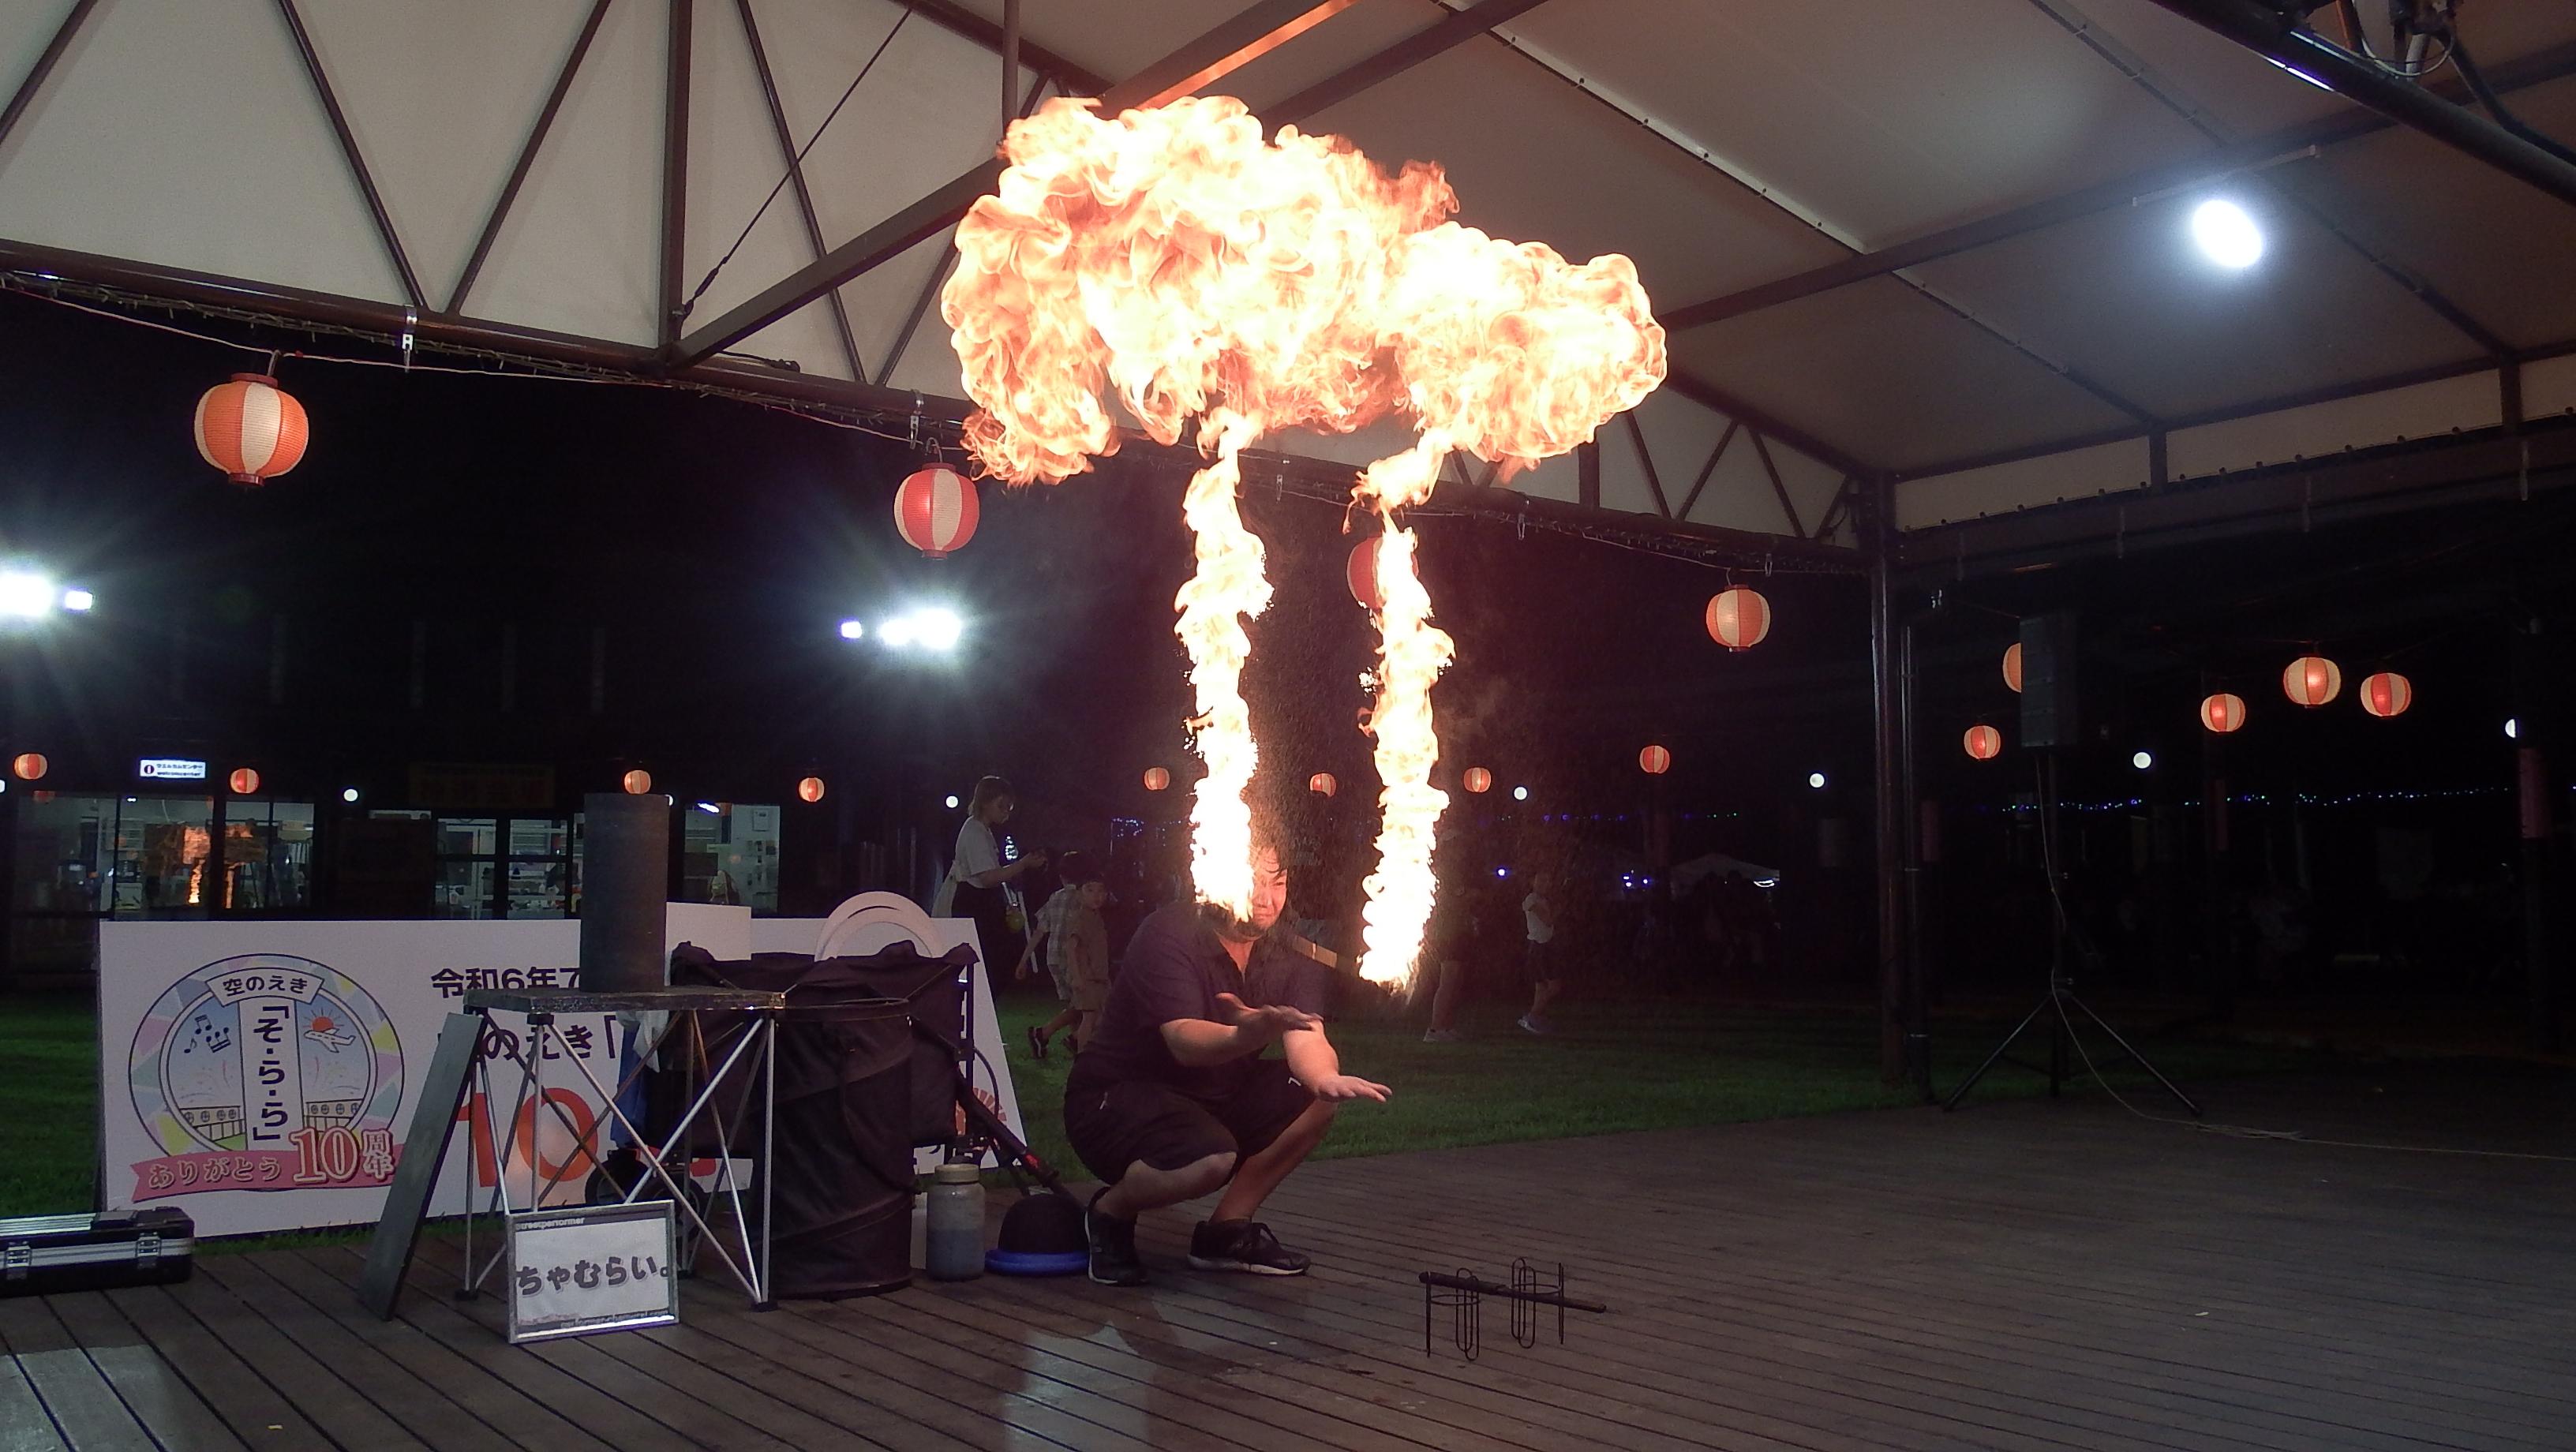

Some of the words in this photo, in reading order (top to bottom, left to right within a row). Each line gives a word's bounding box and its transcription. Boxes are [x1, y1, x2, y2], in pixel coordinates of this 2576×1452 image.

[223, 975, 308, 997] 空のえき
[148, 1156, 281, 1188] ありがとう
